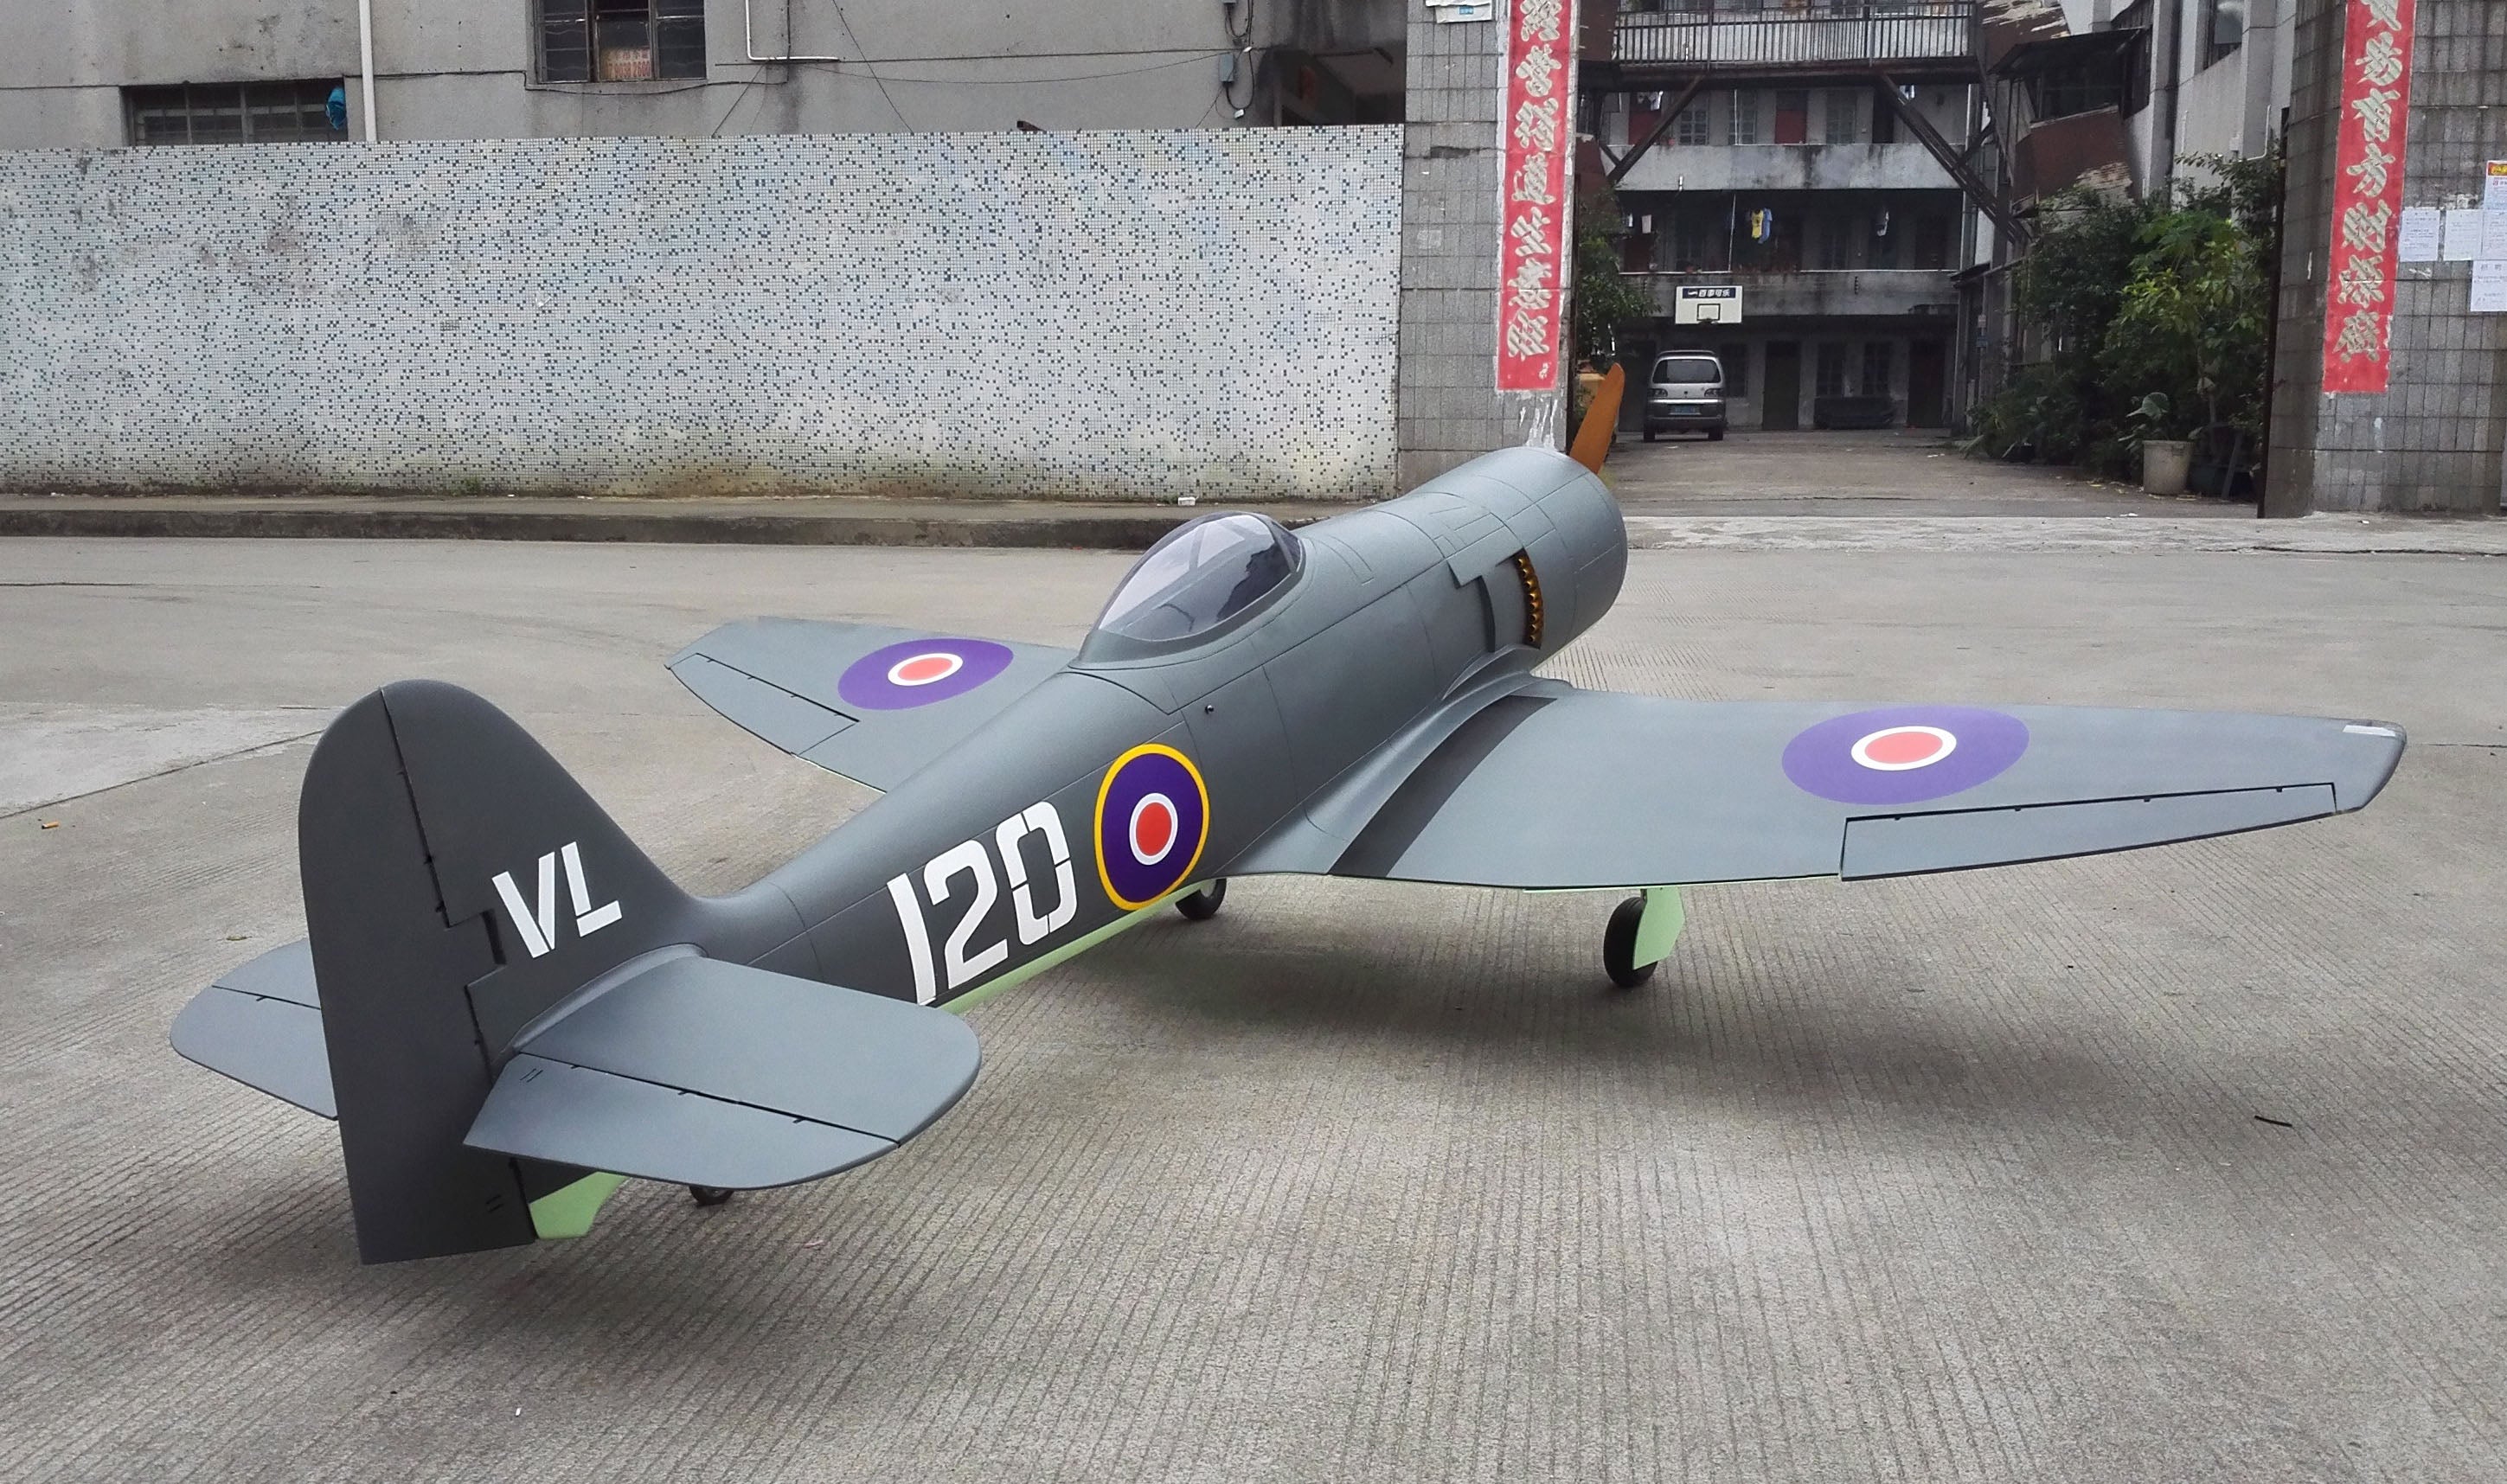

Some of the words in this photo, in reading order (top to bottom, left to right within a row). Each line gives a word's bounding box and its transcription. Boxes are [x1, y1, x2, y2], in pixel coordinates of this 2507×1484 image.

[1698, 289, 1731, 297] 百事可乐
[491, 841, 623, 959] VL
[887, 801, 1078, 1006] 120
